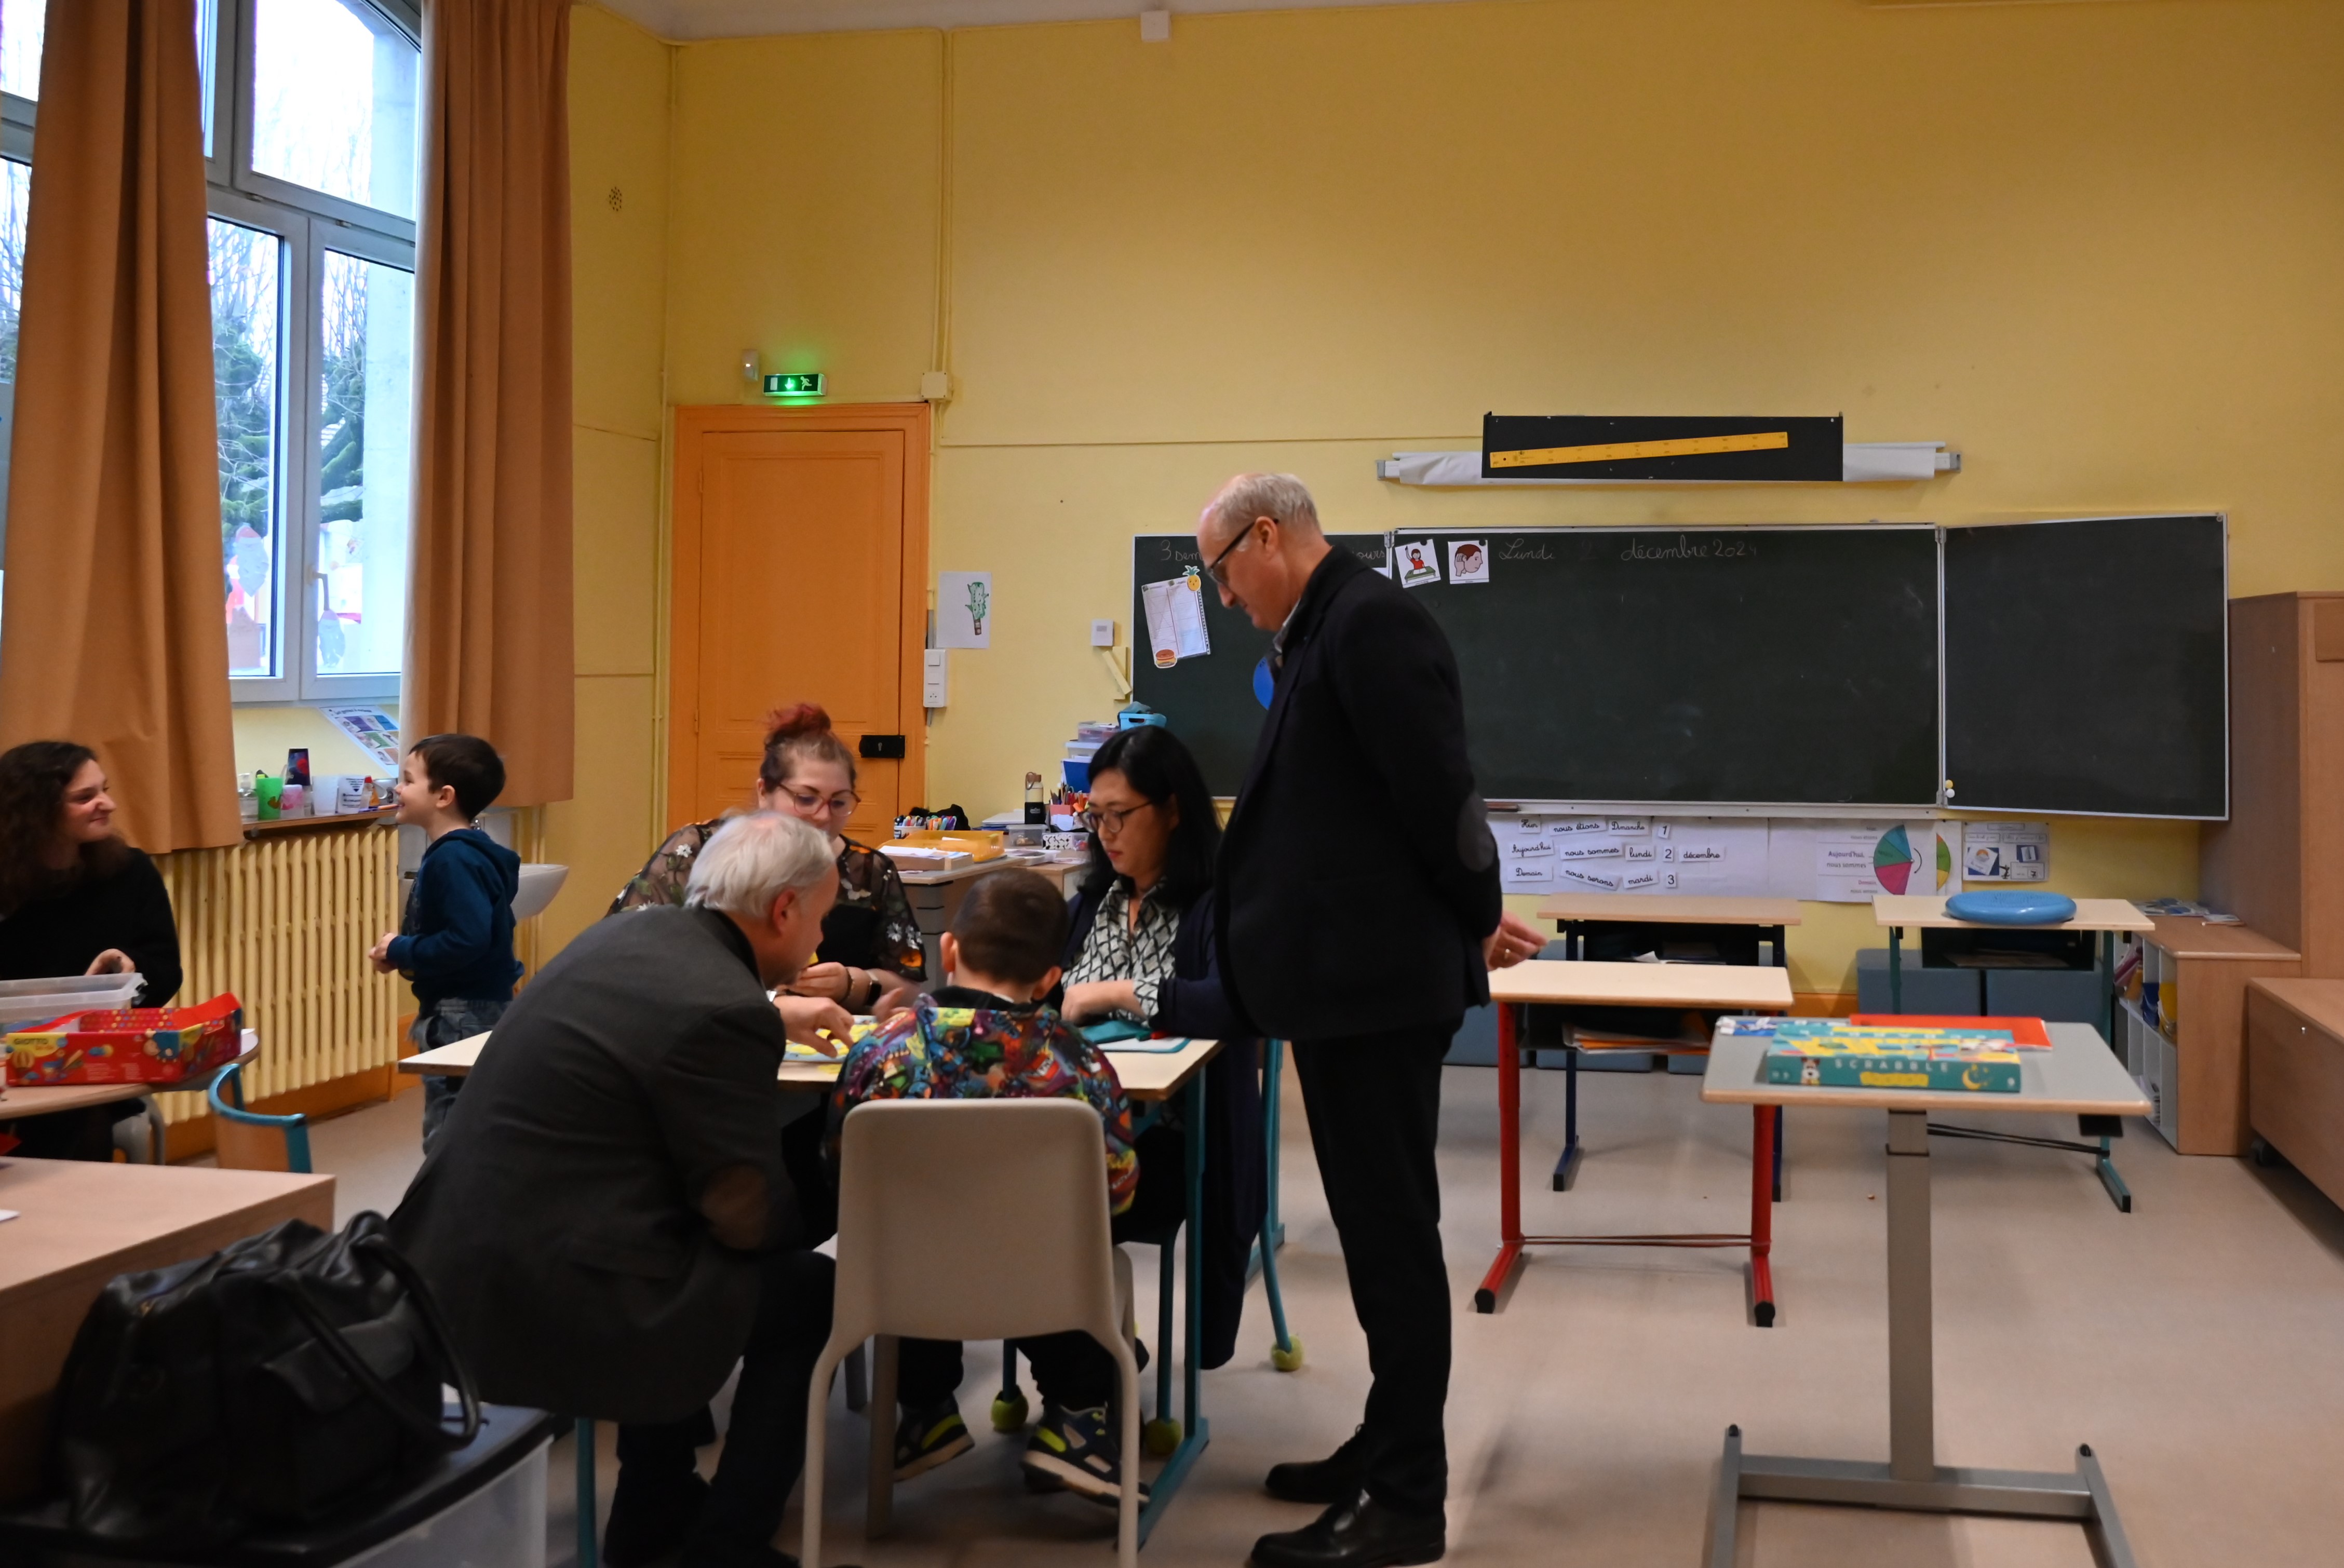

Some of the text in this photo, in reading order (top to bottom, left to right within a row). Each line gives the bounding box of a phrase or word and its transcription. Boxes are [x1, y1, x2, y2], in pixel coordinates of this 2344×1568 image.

[1160, 539, 1171, 561] 3
[1499, 538, 1555, 560] Lundi
[1621, 534, 1710, 561] décembre
[1713, 539, 1757, 558] 2024
[1521, 819, 1538, 828] Hier
[1612, 821, 1645, 830] Dimanche
[1663, 826, 1667, 835] 1
[1629, 847, 1652, 858] lundi
[1665, 849, 1672, 858] 2
[1683, 849, 1720, 859] décembre
[1516, 867, 1675, 886] Demain nous serons mardi 3
[1835, 1058, 1948, 1073] SCRABBLE
